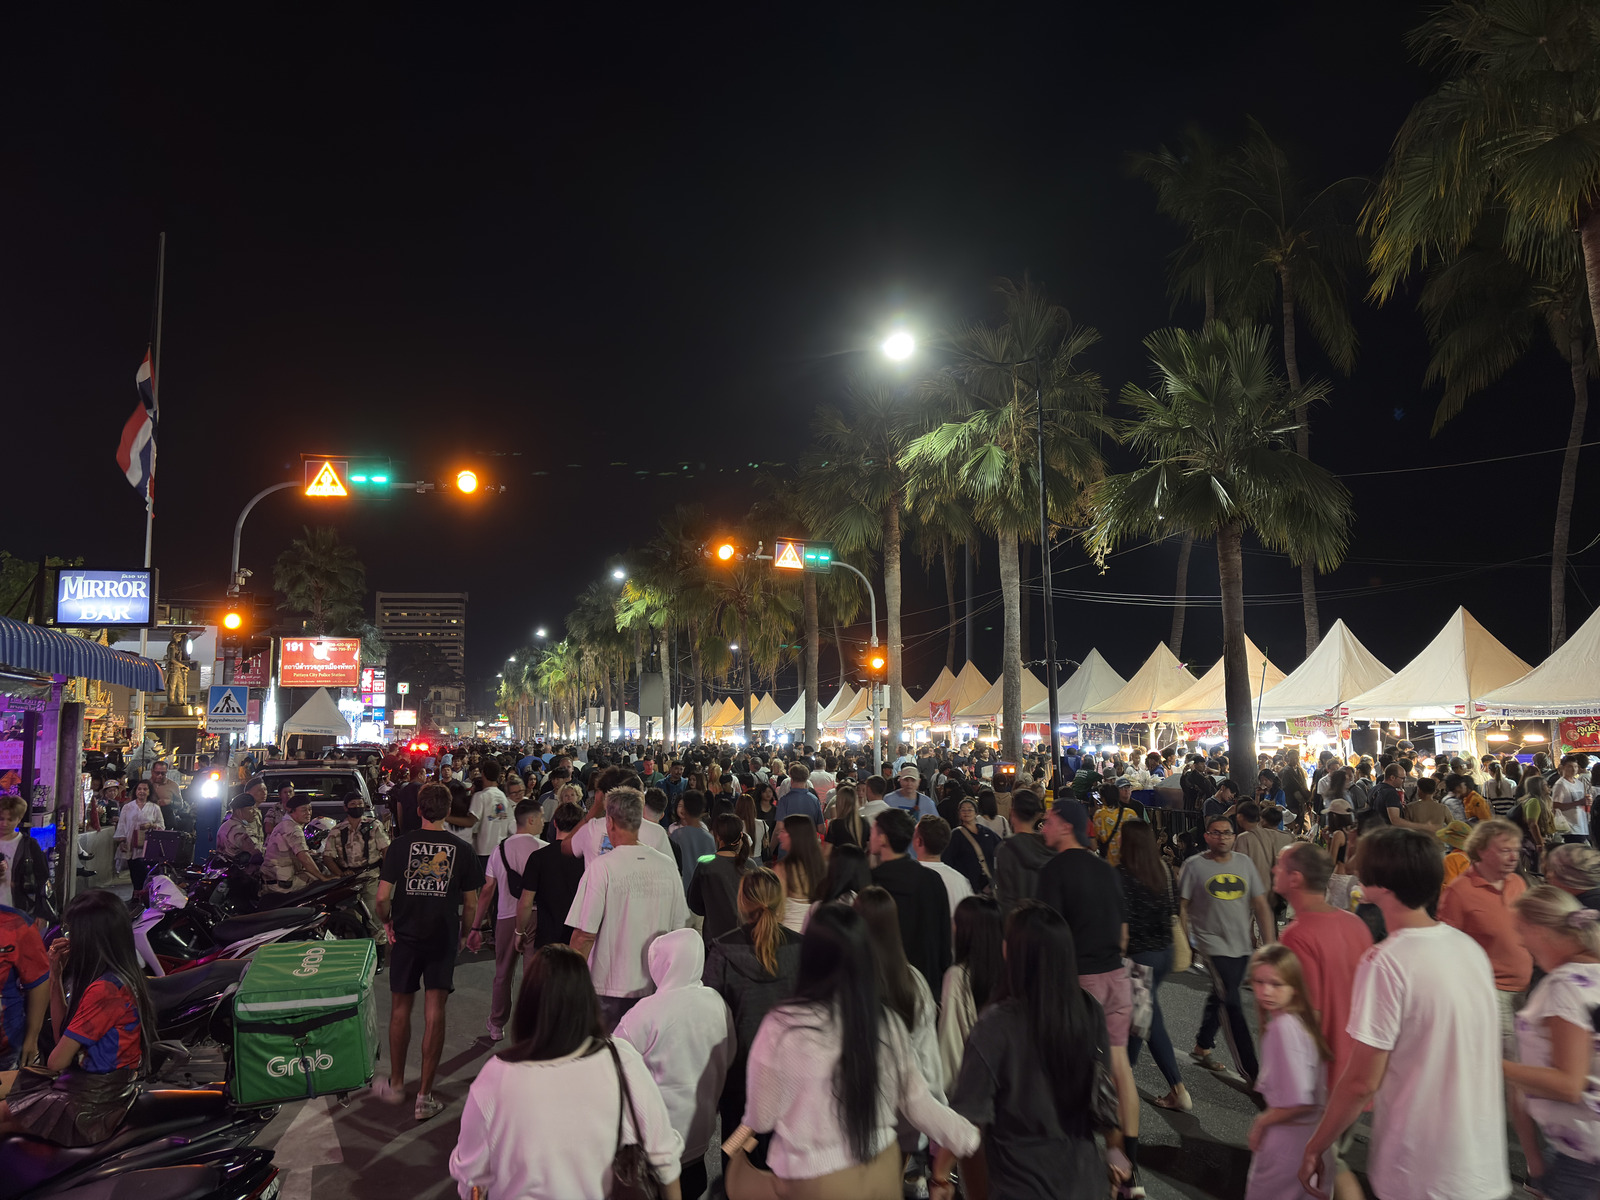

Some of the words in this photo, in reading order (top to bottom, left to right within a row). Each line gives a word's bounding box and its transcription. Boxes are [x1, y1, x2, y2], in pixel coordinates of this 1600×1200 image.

[59, 575, 149, 603] MIRROR
[79, 605, 133, 621] BAR
[285, 641, 304, 652] 191
[411, 844, 455, 857] SALTY
[408, 878, 448, 892] CREW
[292, 947, 326, 977] Grab
[266, 1049, 334, 1078] Grab
